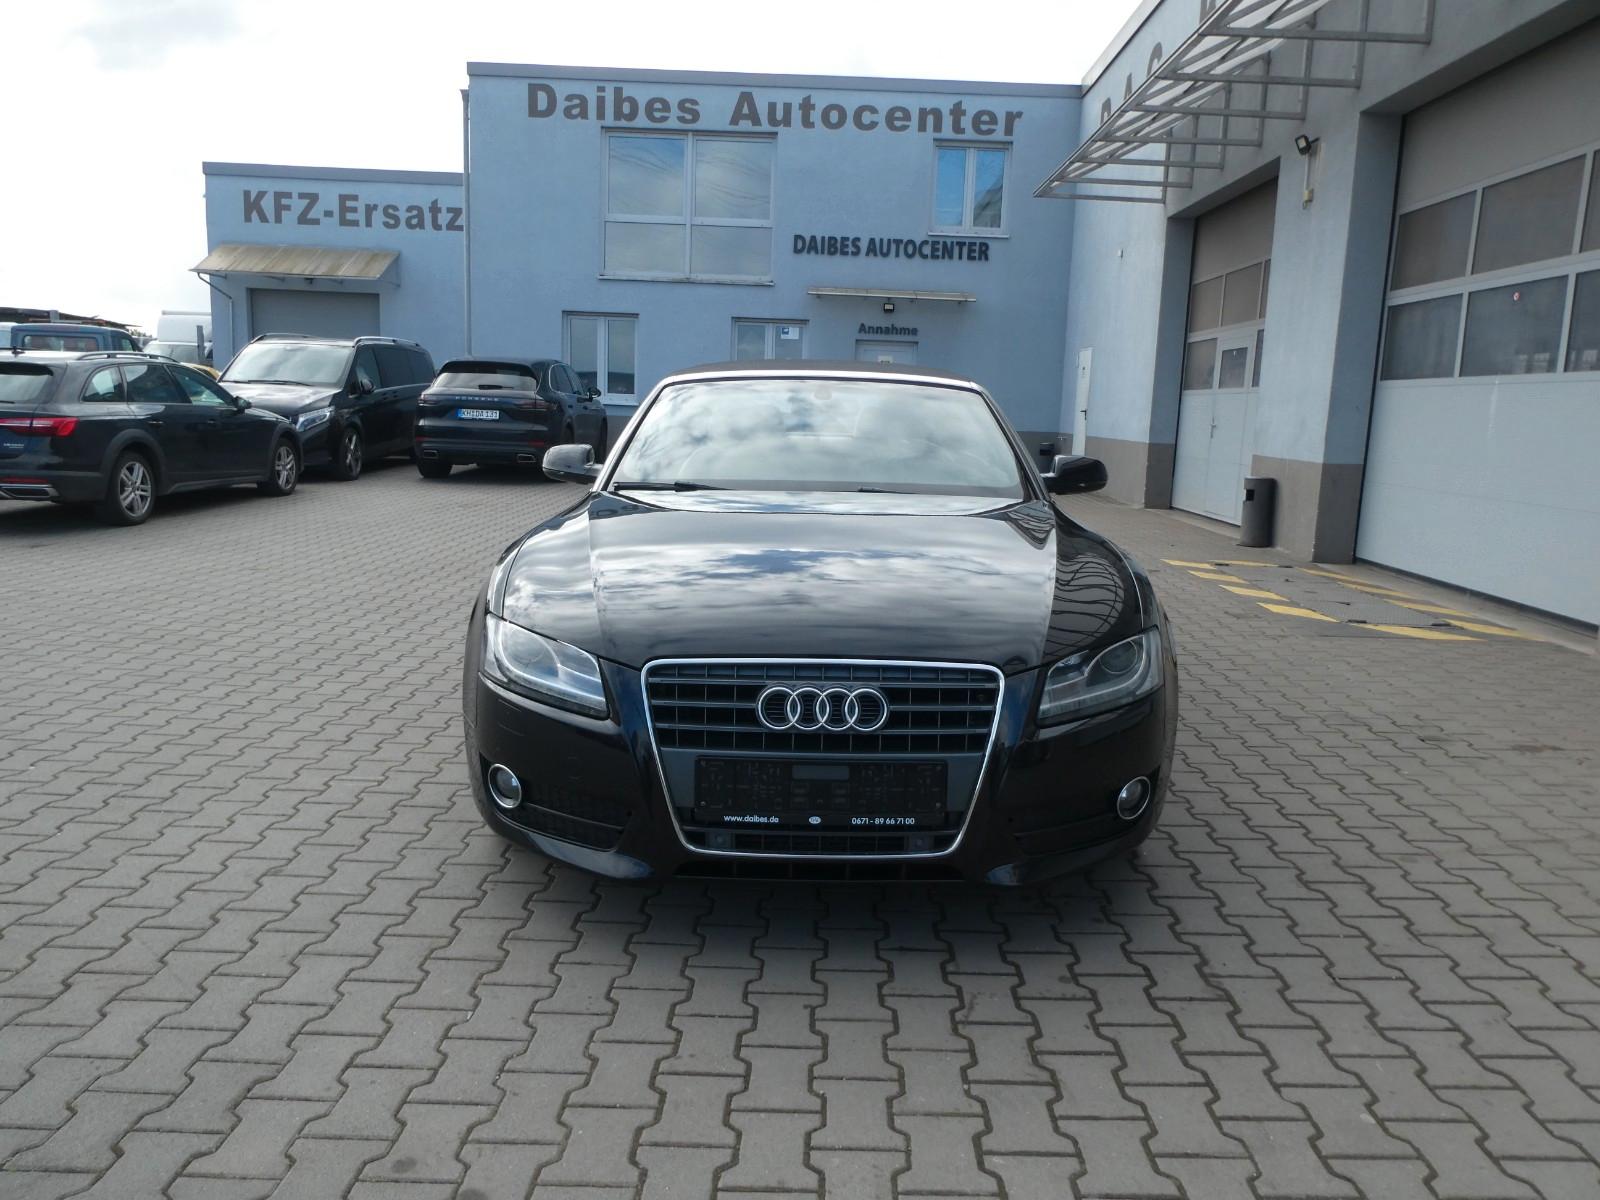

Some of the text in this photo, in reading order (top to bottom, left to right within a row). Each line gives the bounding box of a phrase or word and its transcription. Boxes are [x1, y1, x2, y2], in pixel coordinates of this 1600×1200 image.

[528, 83, 1023, 137] Daibes Autocenter
[243, 190, 464, 231] KFZ-Ersatz
[793, 234, 990, 261] DAIBES AUTOCENTER
[858, 323, 918, 336] Annahme
[851, 817, 869, 825] 0671
[874, 817, 884, 825] 89
[885, 817, 895, 825] 66
[905, 817, 915, 825] 00
